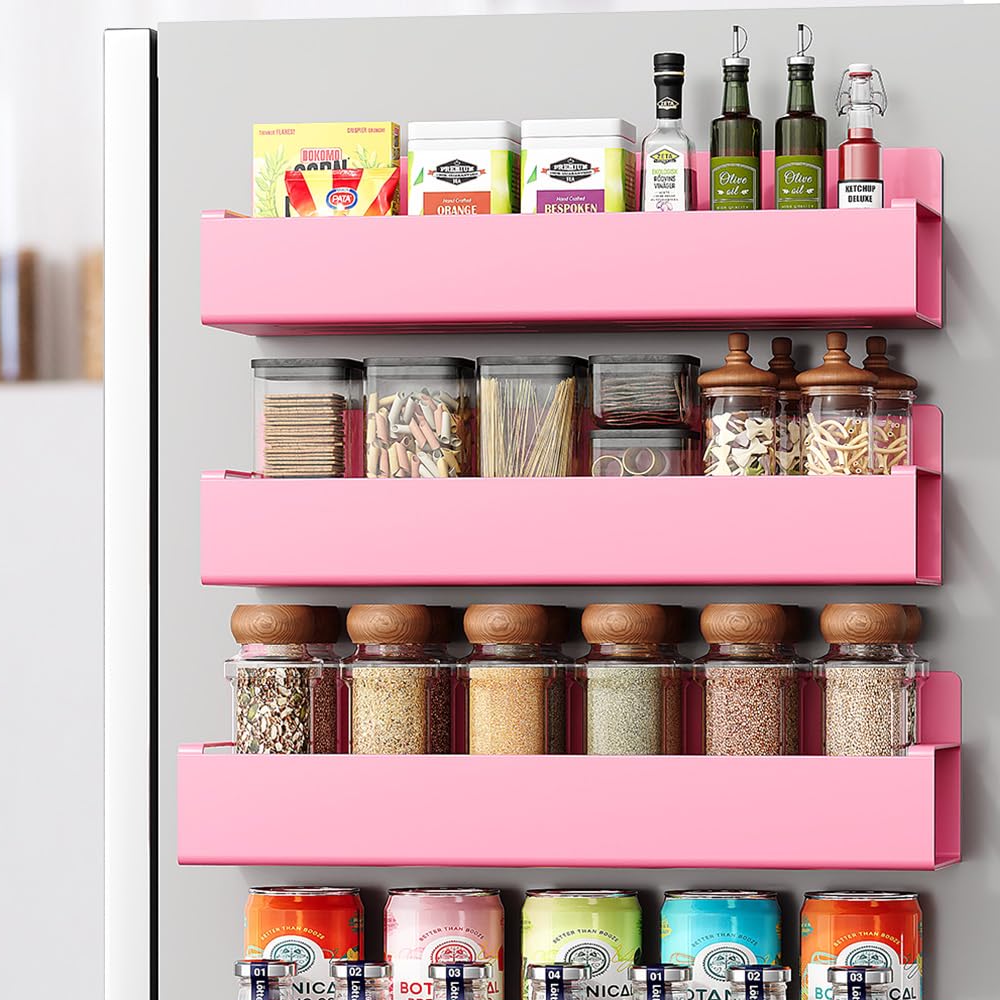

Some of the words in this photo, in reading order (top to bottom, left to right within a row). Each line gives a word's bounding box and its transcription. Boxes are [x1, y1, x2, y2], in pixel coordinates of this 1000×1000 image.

[302, 149, 341, 161] BOKOMO
[719, 171, 748, 186] Olive
[784, 170, 813, 185] Olive
[726, 185, 740, 195] oil
[791, 184, 805, 194] oil
[845, 184, 876, 193] KETCHUP
[847, 195, 873, 203] DELUXE
[437, 205, 478, 215] ORANGE
[544, 203, 598, 213] BESPOKEN
[254, 967, 266, 977] 01
[349, 967, 362, 977] 02
[448, 968, 461, 978] 03
[548, 970, 561, 979] 04
[650, 972, 662, 981] 01
[747, 971, 761, 981] 02
[850, 972, 863, 982] 03
